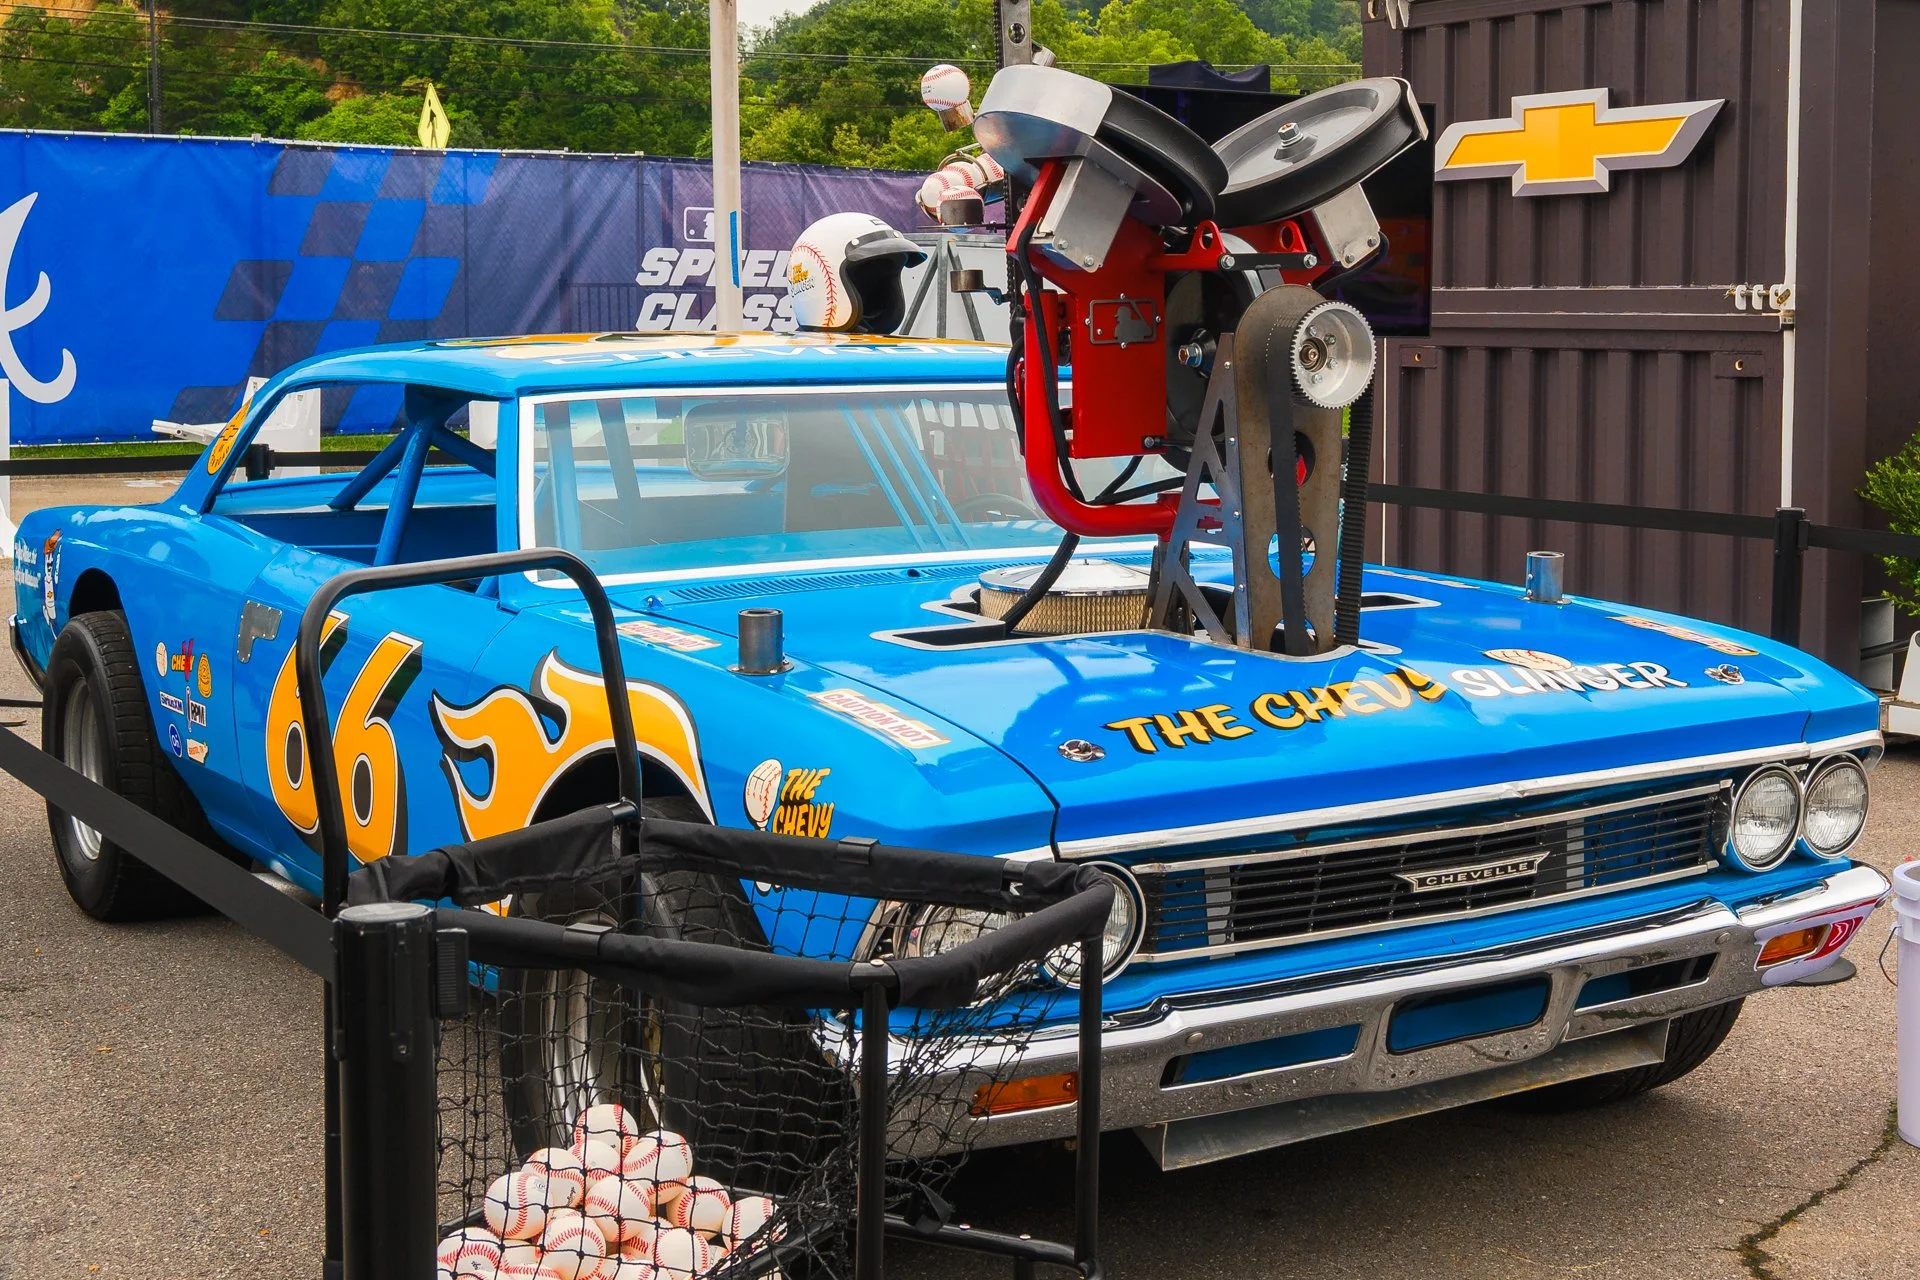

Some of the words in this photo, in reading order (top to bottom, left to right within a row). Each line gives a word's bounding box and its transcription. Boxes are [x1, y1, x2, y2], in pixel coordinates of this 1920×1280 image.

[190, 701, 205, 725] RPM
[823, 693, 899, 725] CAUTION
[887, 723, 933, 742] HOT
[1105, 703, 1255, 754] THE
[1250, 668, 1449, 731] CHEVY
[1447, 660, 1690, 699] SLINGER
[265, 608, 423, 865] 66
[780, 767, 831, 802] THE
[771, 802, 834, 839] CHEVY
[1425, 862, 1529, 886] CHEVELLE
